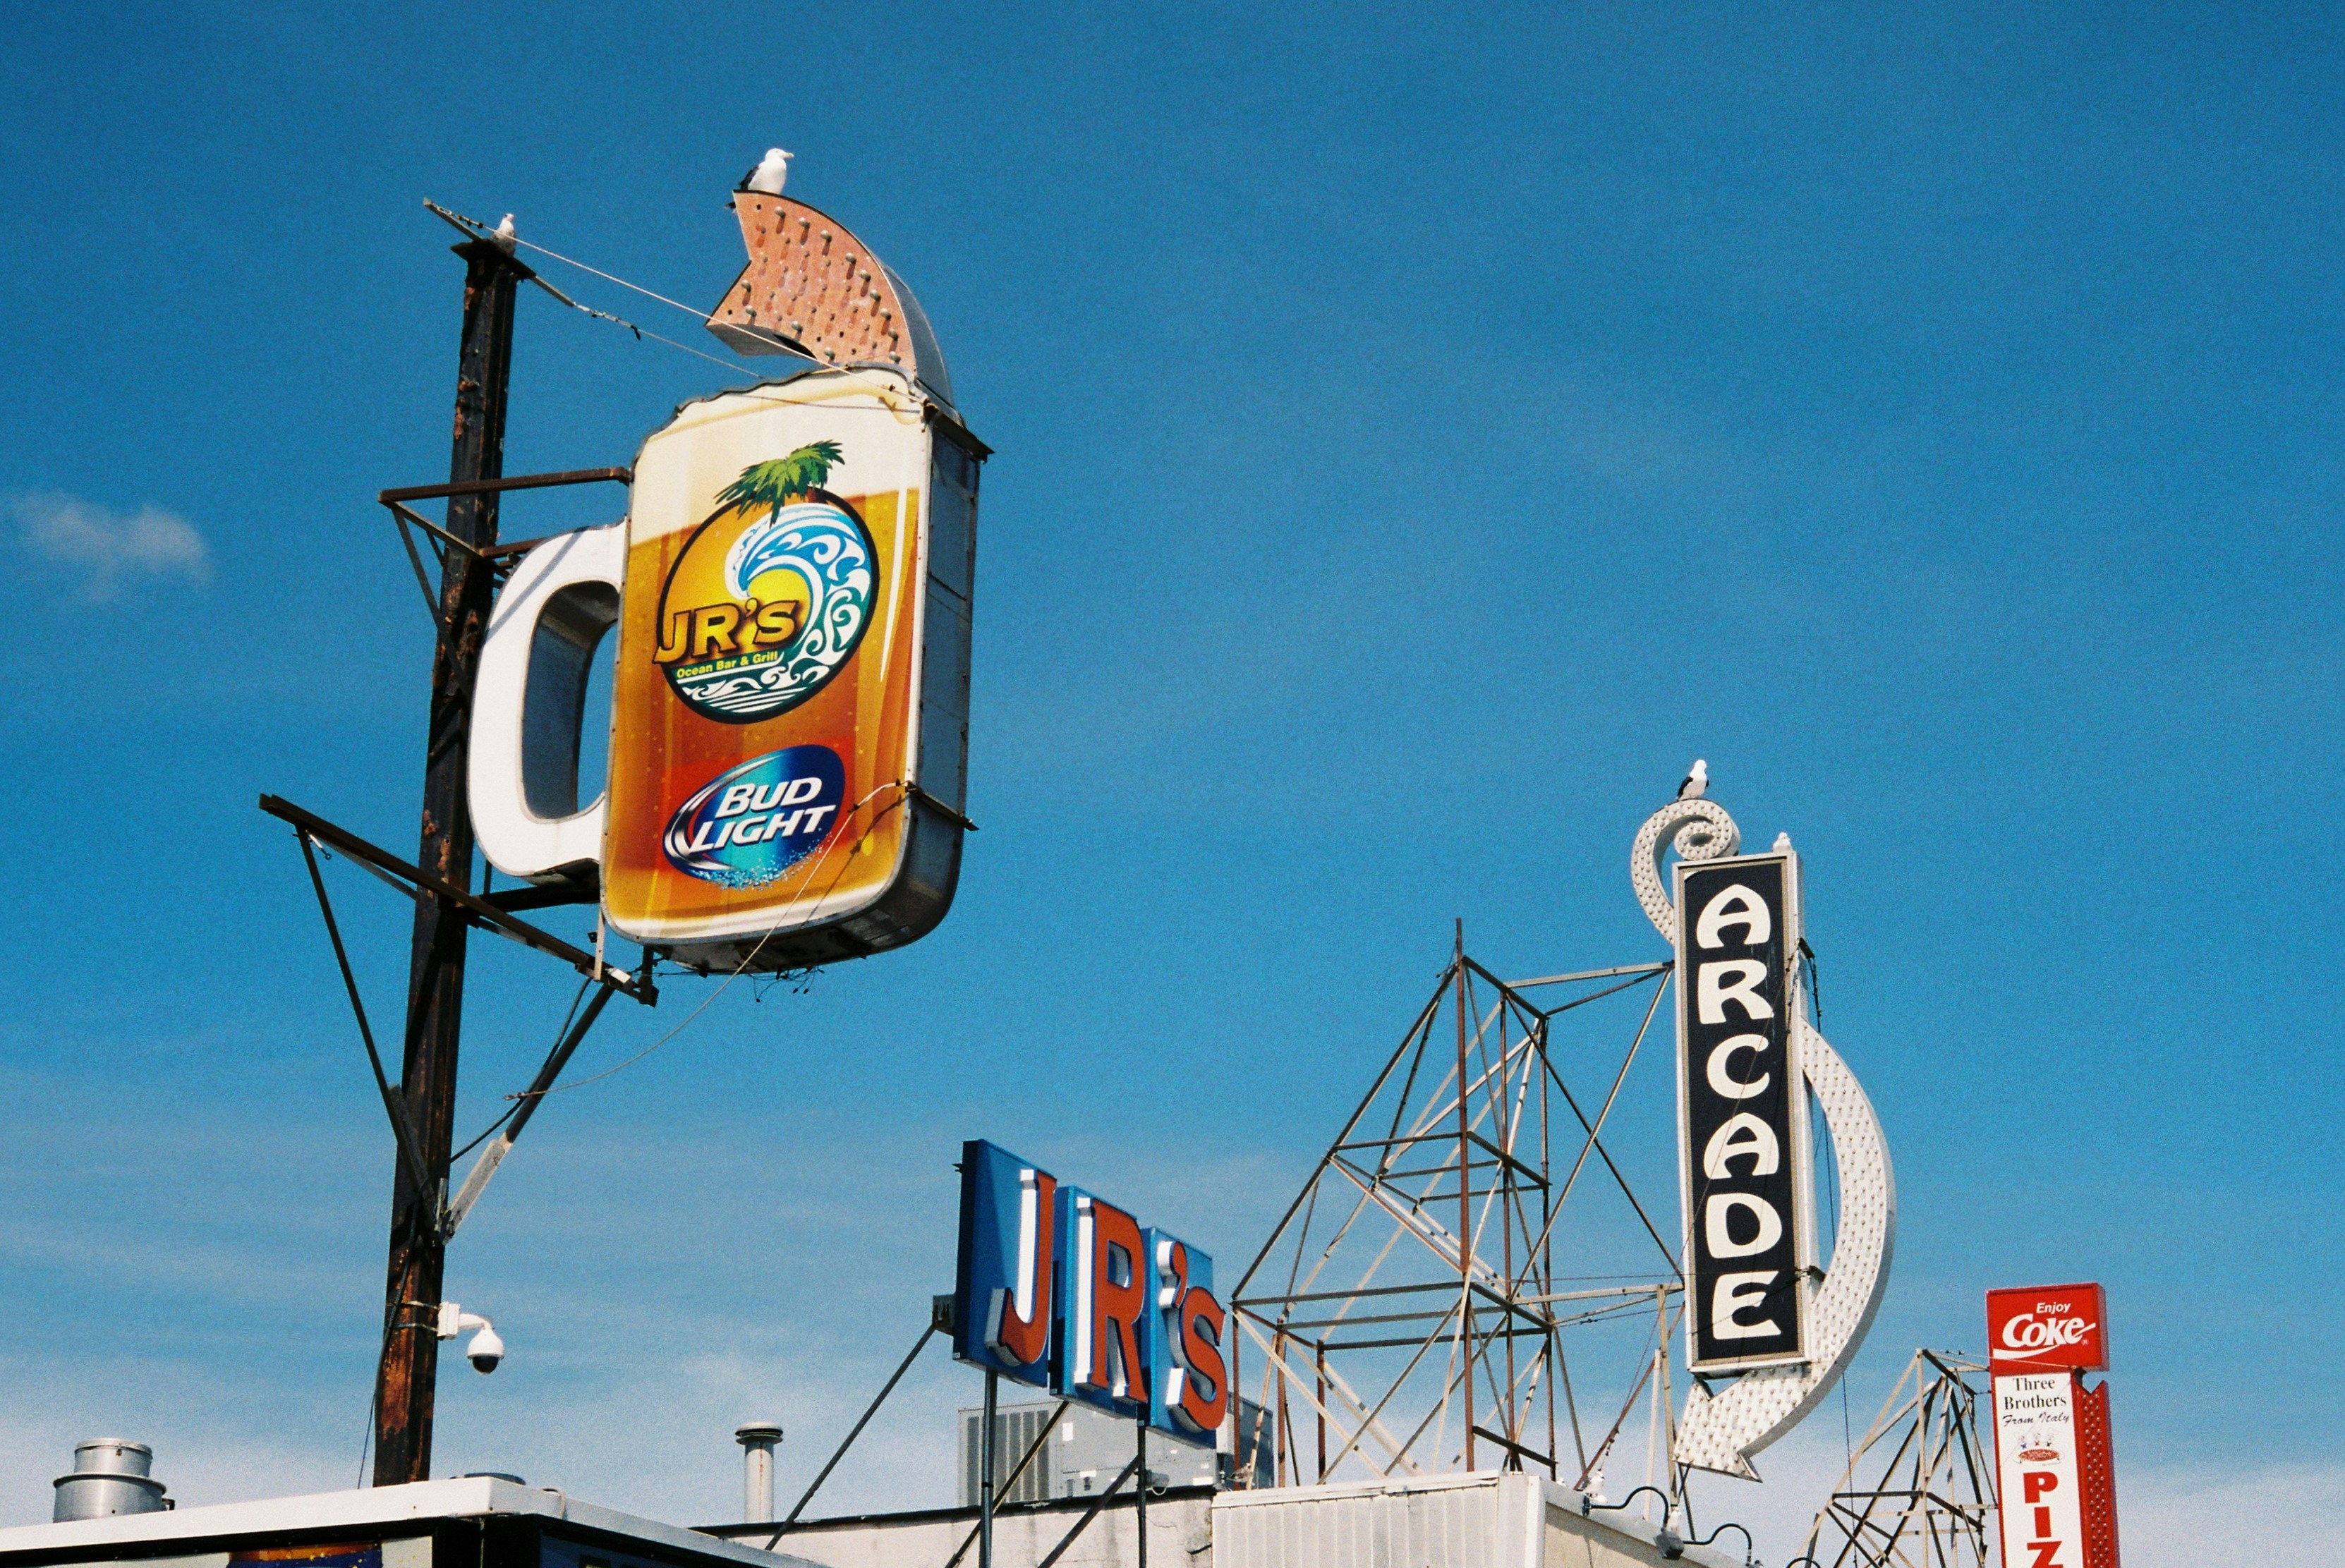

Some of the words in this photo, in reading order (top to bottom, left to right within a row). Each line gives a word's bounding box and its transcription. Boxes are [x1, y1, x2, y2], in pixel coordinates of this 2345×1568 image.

[677, 665, 713, 679] Ocean
[716, 660, 737, 671] Bar
[740, 657, 749, 666] &
[752, 650, 778, 664] Grill
[715, 777, 823, 820] BUD
[687, 804, 837, 853] LIGHT
[1696, 883, 1783, 1340] ARCADE
[2036, 1301, 2071, 1314] Enjoy
[2002, 1313, 2097, 1348] Coke
[2013, 1377, 2056, 1391] Three
[2004, 1394, 2068, 1410] Brothers
[2002, 1414, 2035, 1427] From
[2039, 1411, 2070, 1423] Italy
